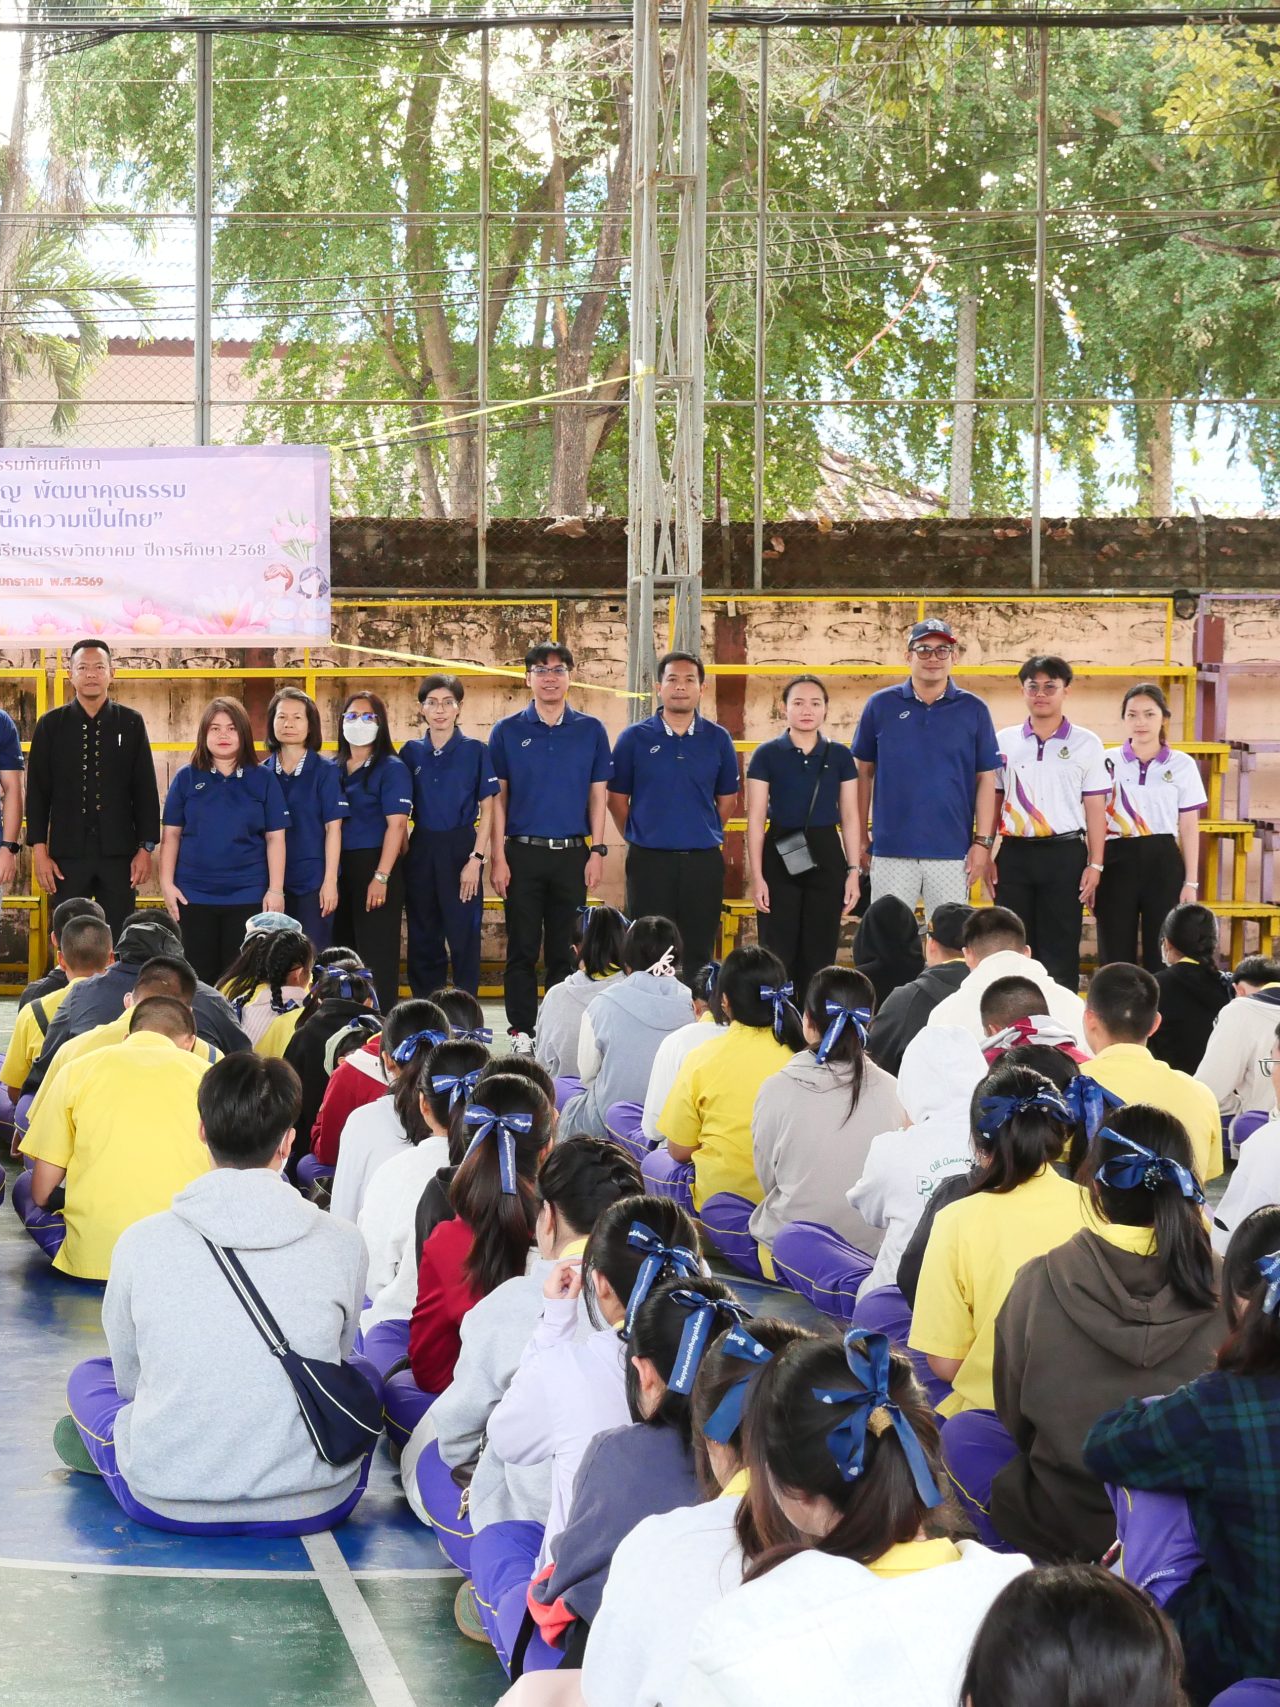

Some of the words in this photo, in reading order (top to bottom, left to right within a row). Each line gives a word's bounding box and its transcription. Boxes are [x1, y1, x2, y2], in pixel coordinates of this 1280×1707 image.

[34, 480, 187, 506] พัฒนาคุณธรรม
[144, 542, 223, 557] ปีการศึกษา
[228, 543, 267, 556] 2568
